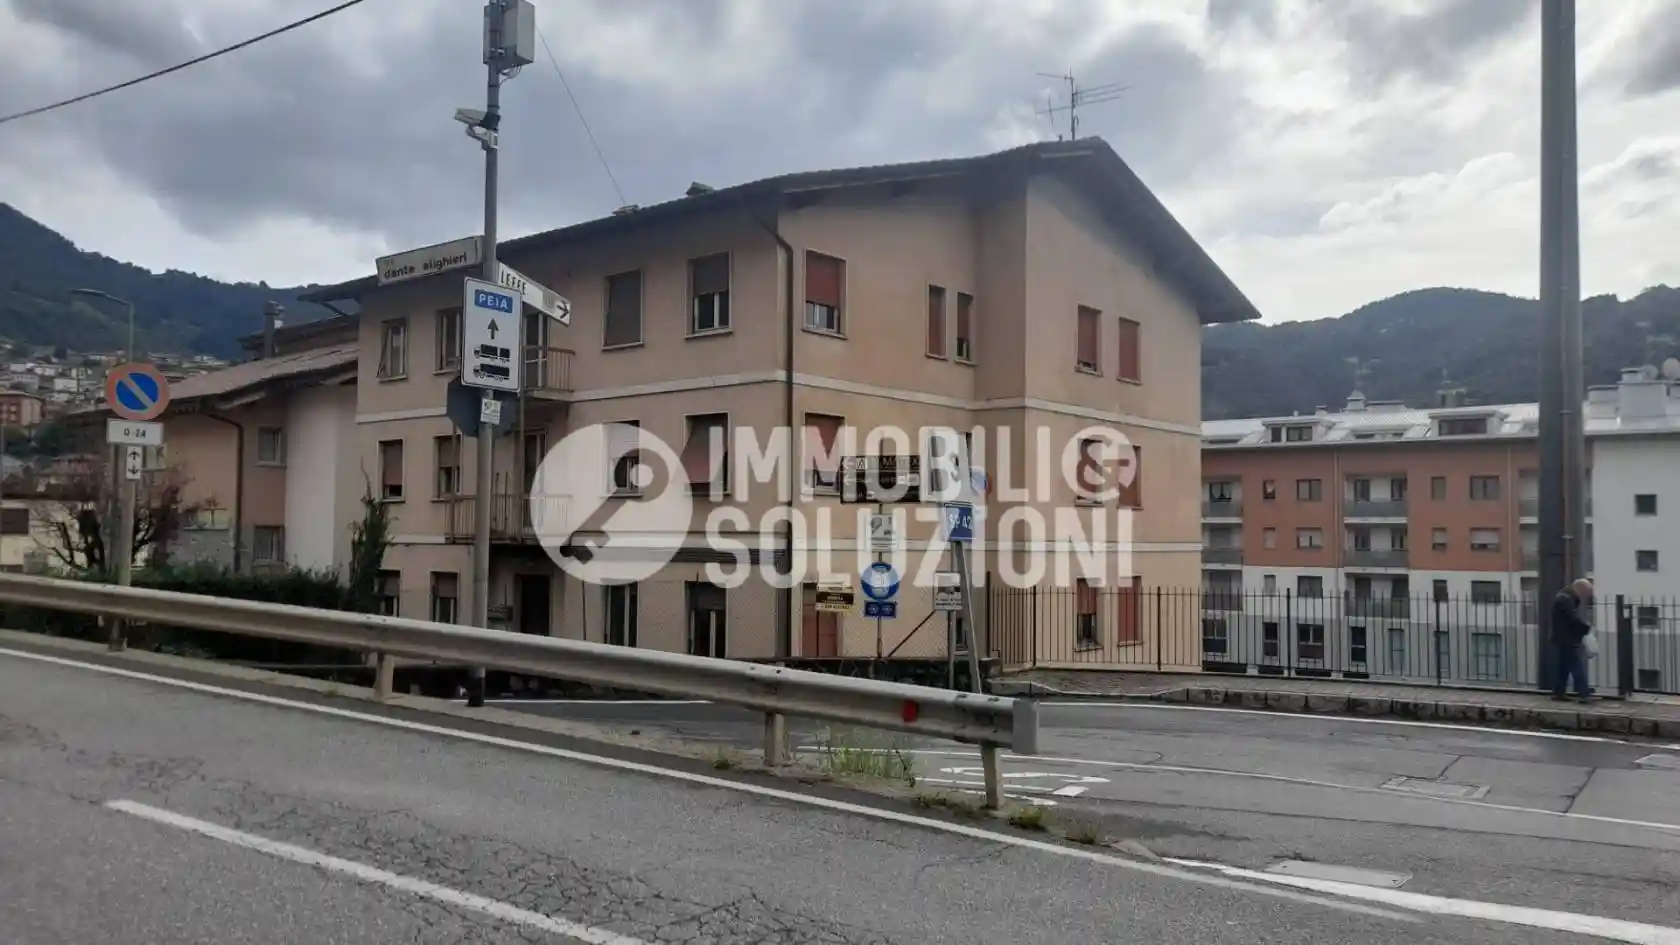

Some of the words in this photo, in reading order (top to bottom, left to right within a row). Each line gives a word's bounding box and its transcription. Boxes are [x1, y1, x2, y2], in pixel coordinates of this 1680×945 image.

[384, 265, 415, 279] dante
[423, 252, 467, 270] alighieri
[501, 269, 527, 295] LEFFE
[479, 293, 508, 310] PEIA
